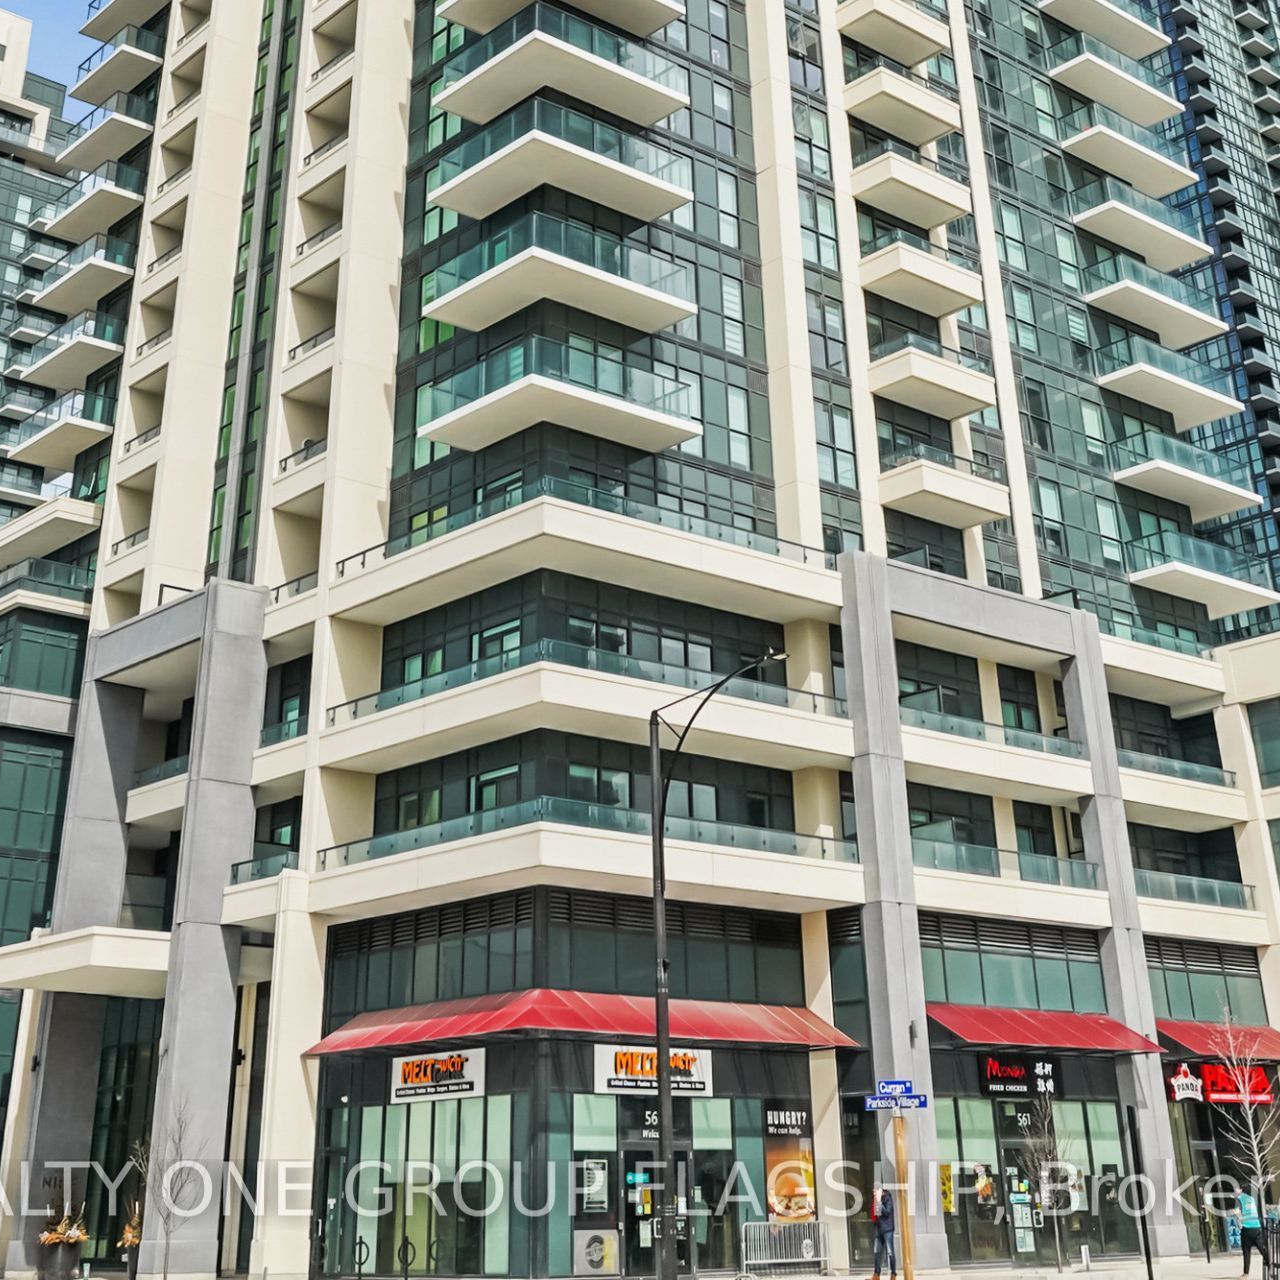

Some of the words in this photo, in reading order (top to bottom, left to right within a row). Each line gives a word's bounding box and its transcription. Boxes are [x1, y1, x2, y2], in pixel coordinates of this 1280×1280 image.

[1202, 1064, 1271, 1091] PANDA
[880, 1082, 905, 1093] Curran
[1177, 1083, 1199, 1093] PANDA
[645, 1110, 658, 1126] 56
[767, 1111, 807, 1125] HUNGRY?
[1017, 1113, 1031, 1126] 561
[768, 1126, 777, 1134] We
